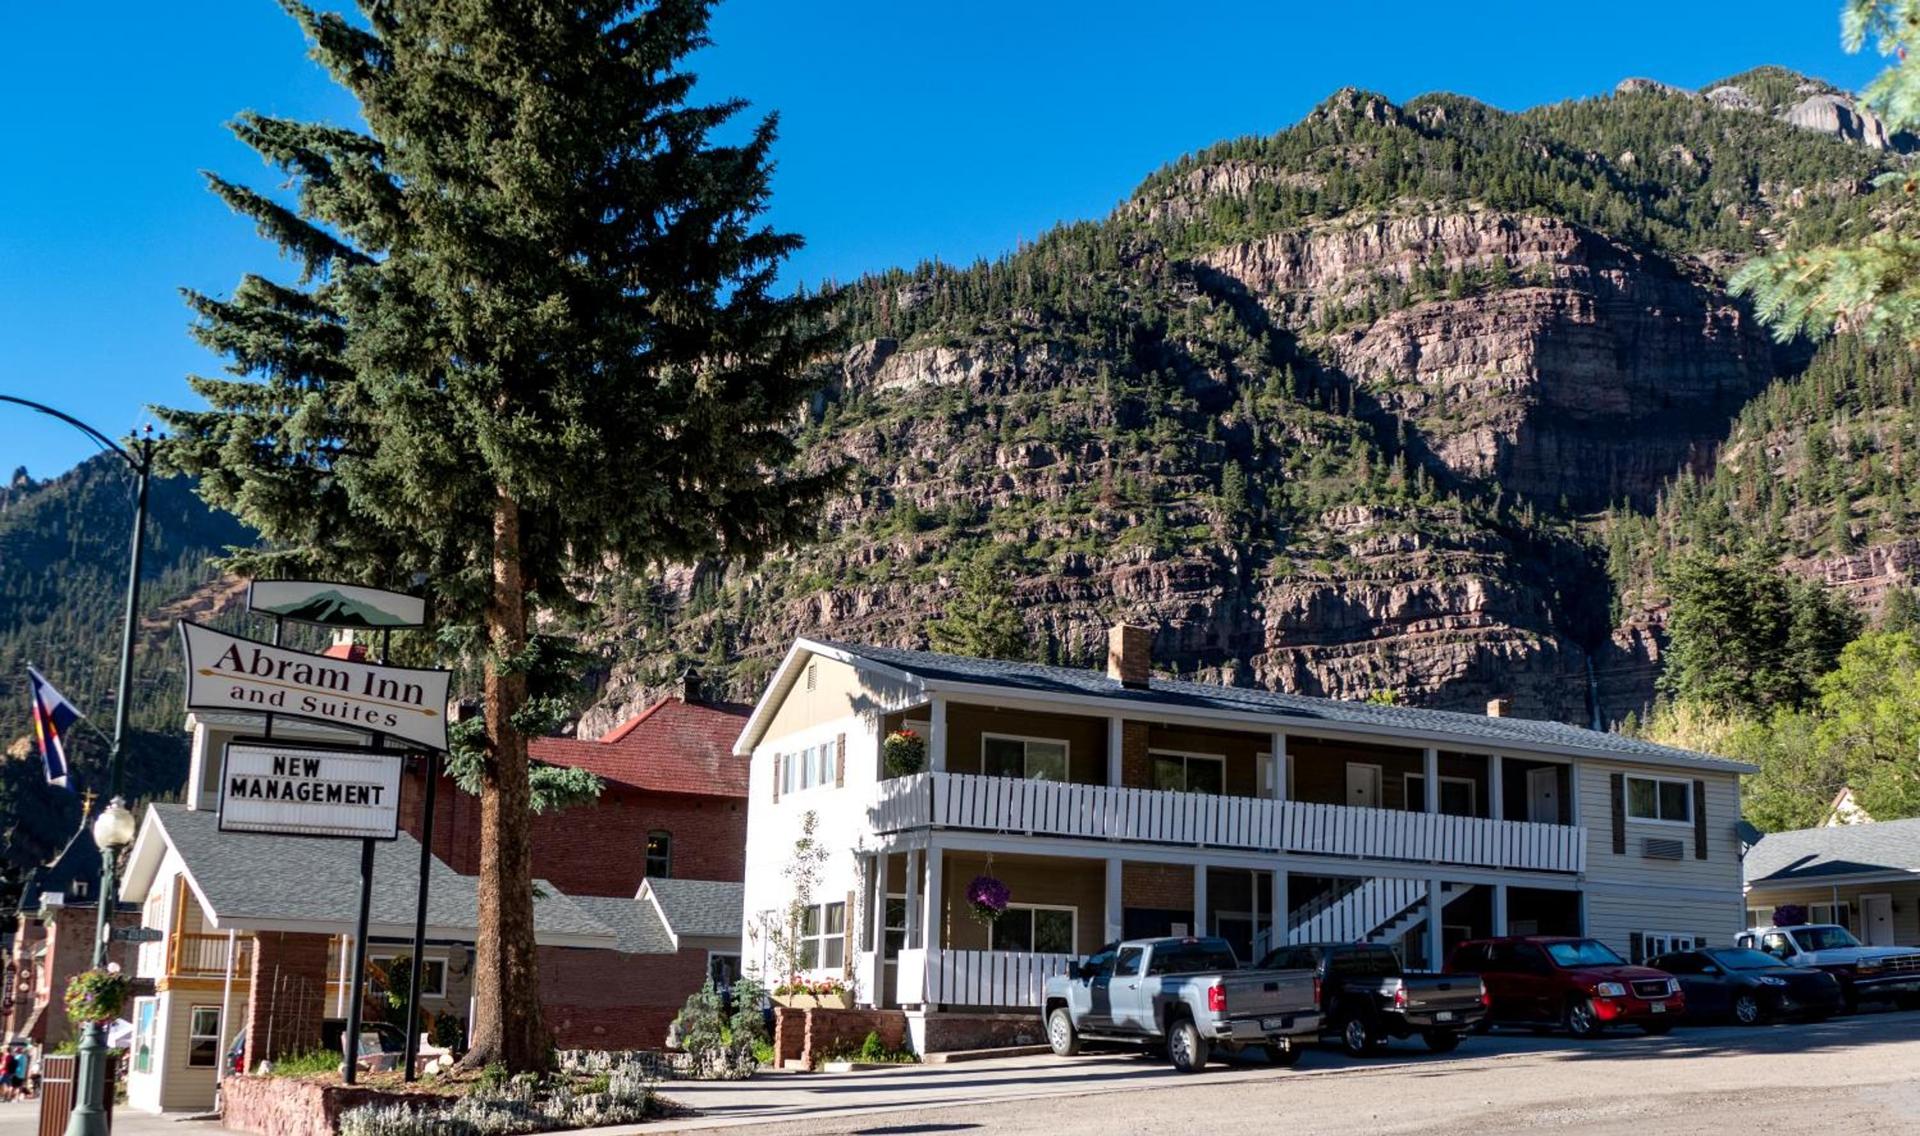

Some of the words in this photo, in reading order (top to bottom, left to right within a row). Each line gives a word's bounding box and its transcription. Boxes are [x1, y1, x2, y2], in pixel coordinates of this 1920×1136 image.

[213, 643, 350, 692] Abram
[362, 672, 424, 705] Inn
[230, 686, 286, 707] and
[300, 695, 398, 727] Suites
[272, 756, 321, 778] NEW
[230, 777, 385, 805] MANAGEMENT
